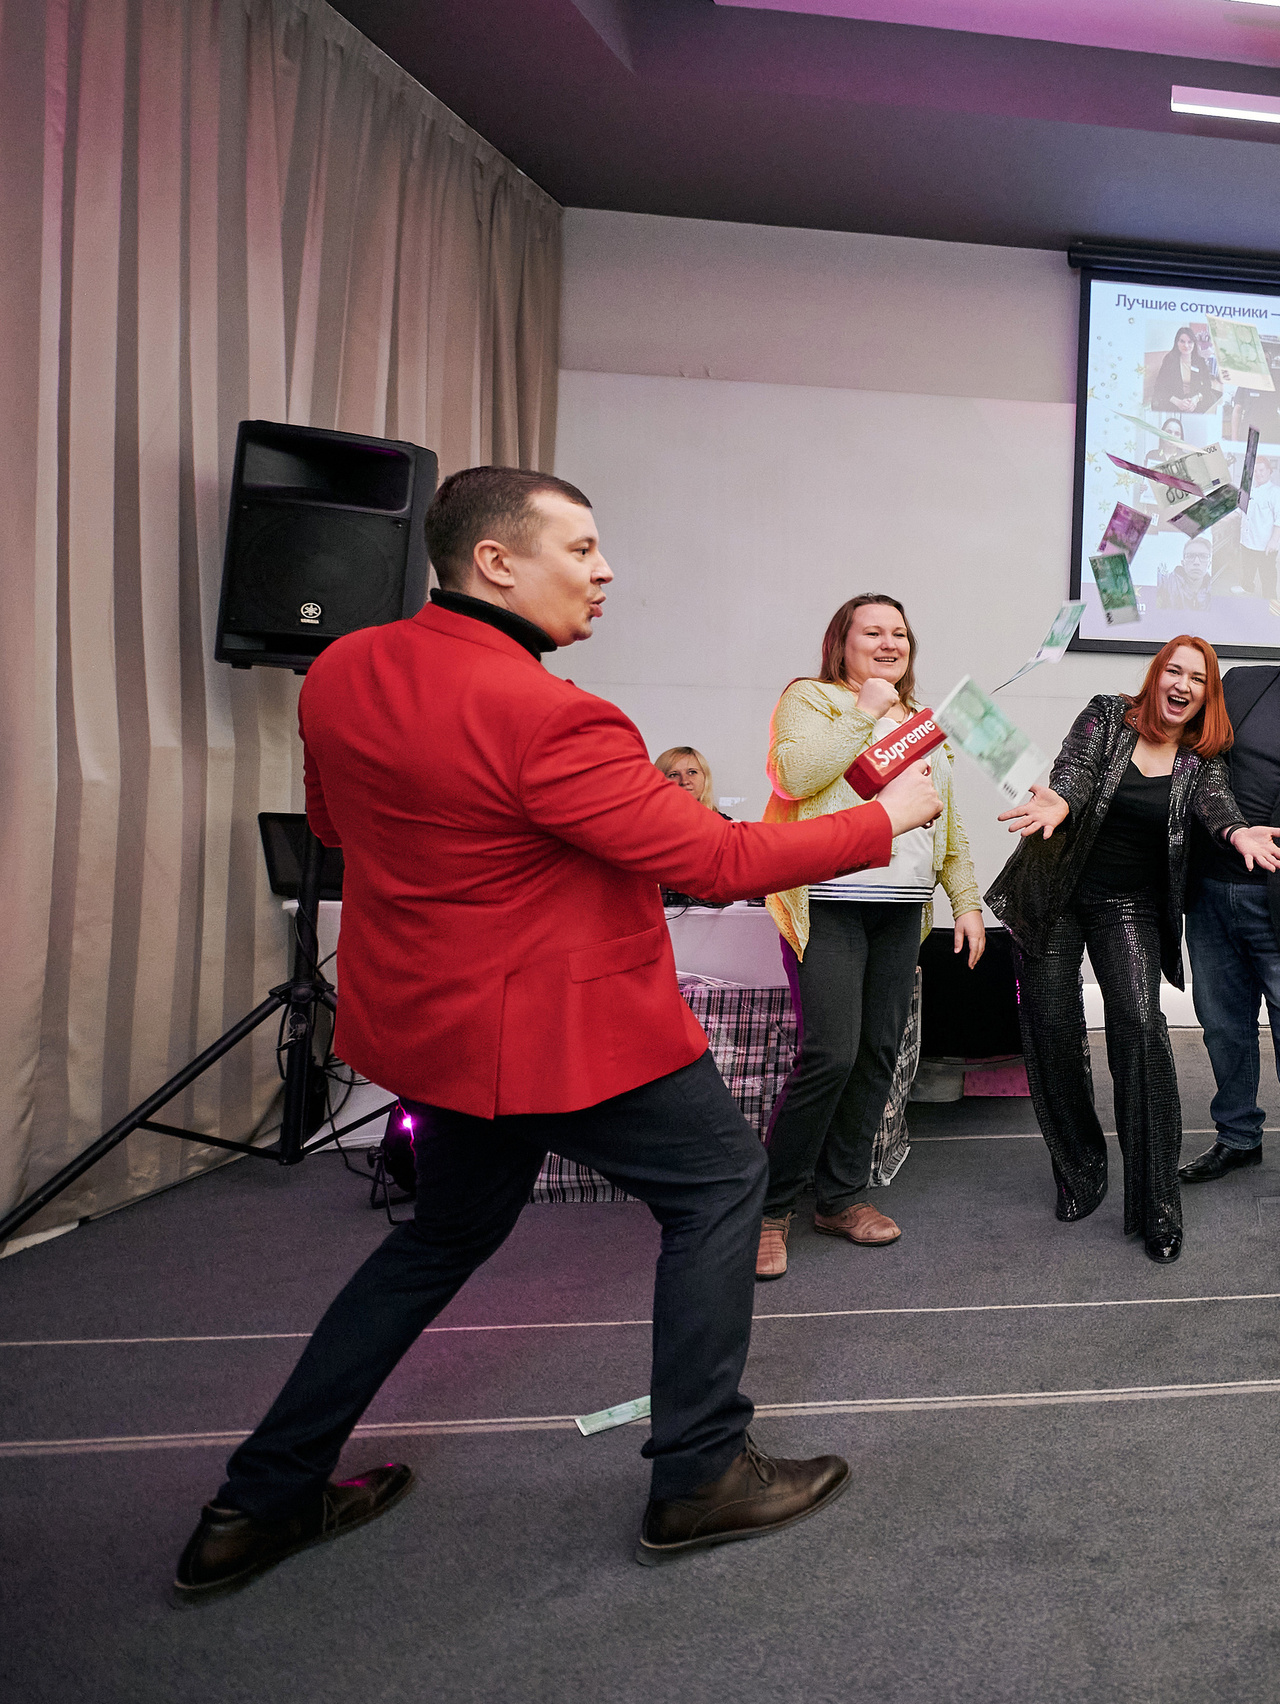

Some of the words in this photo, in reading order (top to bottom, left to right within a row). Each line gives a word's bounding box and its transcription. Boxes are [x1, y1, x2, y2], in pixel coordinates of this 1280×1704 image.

[1115, 293, 1177, 312] Лучшие
[1180, 302, 1268, 319] сотрудники
[873, 719, 936, 768] Supreme
